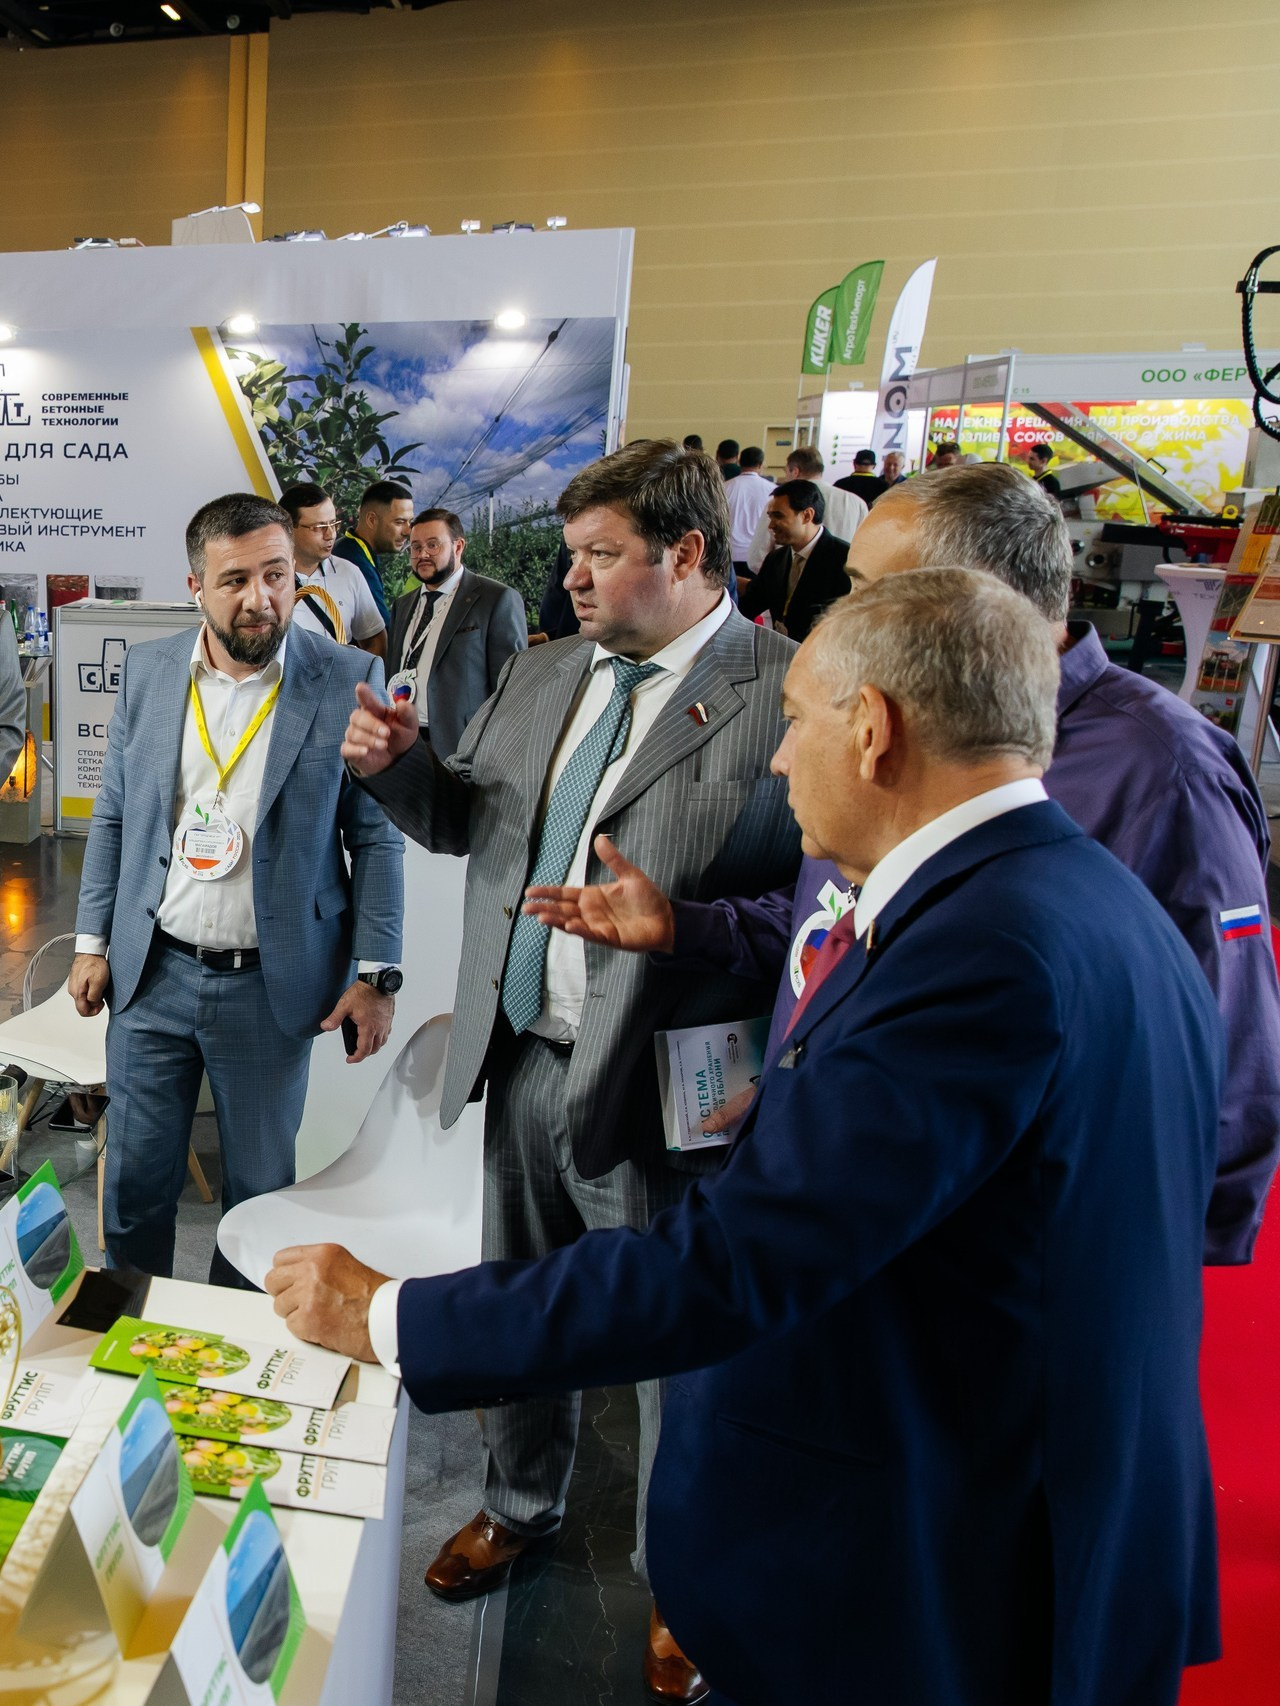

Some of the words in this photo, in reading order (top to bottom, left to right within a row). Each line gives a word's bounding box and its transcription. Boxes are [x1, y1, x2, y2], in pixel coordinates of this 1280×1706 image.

[843, 279, 866, 360] АгроТехИмпорт
[809, 305, 832, 367] KUKER
[1141, 368, 1187, 383] ООО
[41, 392, 129, 402] СОВРЕМЕННЫЕ
[41, 405, 105, 414] БЕТОННЫЕ
[41, 417, 119, 426] ТЕХНОЛОГИИ
[1016, 416, 1083, 428] РЕШИЯ
[1121, 414, 1240, 427] ПРОИЗВОДСТВА
[933, 432, 943, 443] И
[1014, 431, 1065, 442] СОКОВ
[5, 443, 54, 462] ДЛЯ
[63, 443, 129, 462] САДА
[37, 525, 147, 538] ИНСТРУМЕНТ
[86, 672, 120, 686] СБ
[78, 723, 110, 738] ВС
[78, 749, 106, 757] СТОЛБ
[78, 757, 103, 765] СЕТКА
[78, 773, 102, 782] САДО
[78, 781, 103, 789] ТЕХНИ
[705, 1041, 715, 1075] ХРАНЕНИЯ
[714, 1058, 725, 1094] ЯБЛОНИ
[696, 1069, 714, 1138] ССТЕМА
[257, 1349, 288, 1390] ФРУТТИС
[281, 1357, 307, 1386] ГРУПП
[1, 1370, 39, 1420] ФРУТТИС
[24, 1382, 55, 1416] ГРУПП
[303, 1408, 326, 1446] ФРУТТ
[296, 1454, 316, 1497] ФРУТТ
[321, 1459, 338, 1490] ГРУП
